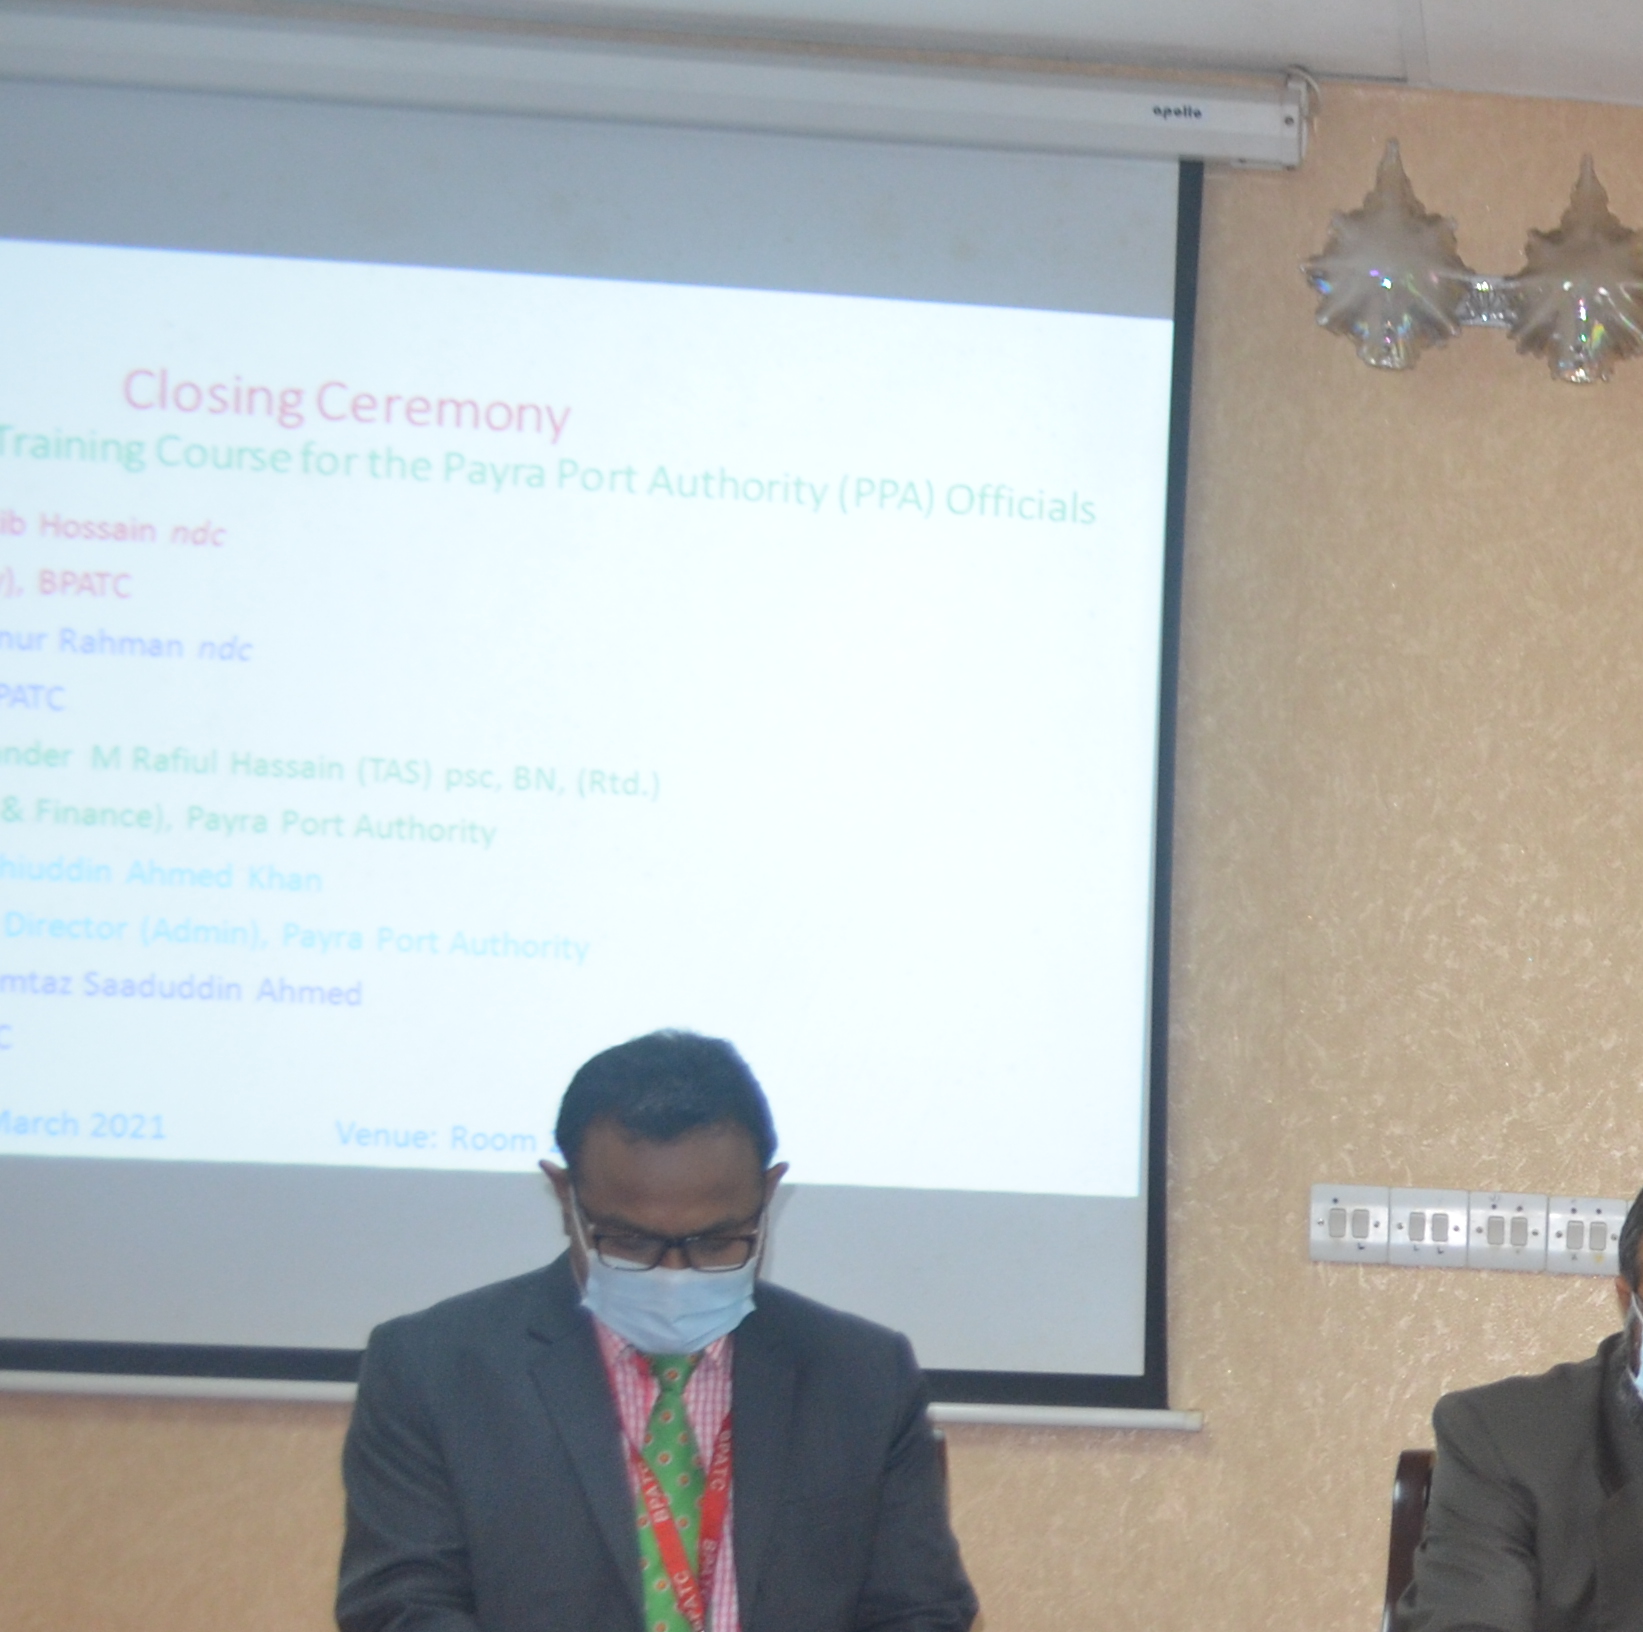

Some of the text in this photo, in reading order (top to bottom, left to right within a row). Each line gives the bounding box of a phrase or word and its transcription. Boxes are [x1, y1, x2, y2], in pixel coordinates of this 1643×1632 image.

[123, 368, 572, 444] Closing Ceremony
[156, 434, 292, 474] Course
[300, 441, 359, 478] for
[368, 447, 432, 482] the
[444, 452, 546, 493] Payra
[558, 459, 637, 493] Port
[646, 467, 828, 514] Authority
[839, 474, 936, 518] (PPA)
[946, 482, 1096, 525] Officials
[39, 512, 156, 543] Hossain
[171, 519, 227, 547] ndc
[38, 570, 133, 599] BPATC
[59, 627, 184, 658] Rahman
[199, 635, 253, 663] ndc
[91, 745, 121, 770] M
[133, 747, 217, 775] Rafiul
[231, 753, 344, 782] Hassain
[357, 756, 432, 788] (TAS)
[3, 798, 23, 821] &
[186, 806, 268, 837] Payra
[281, 811, 344, 838] Port
[353, 814, 497, 848] Authority
[125, 859, 234, 889] Ahmed
[249, 864, 323, 892] Khan
[5, 910, 590, 966] Director (Admin), Payra Port Authority
[83, 972, 243, 1002] Saaduddin
[256, 976, 363, 1006] Ahmed
[90, 1113, 166, 1139] 2021
[335, 1118, 437, 1150] Venue:
[451, 1125, 536, 1152] Room
